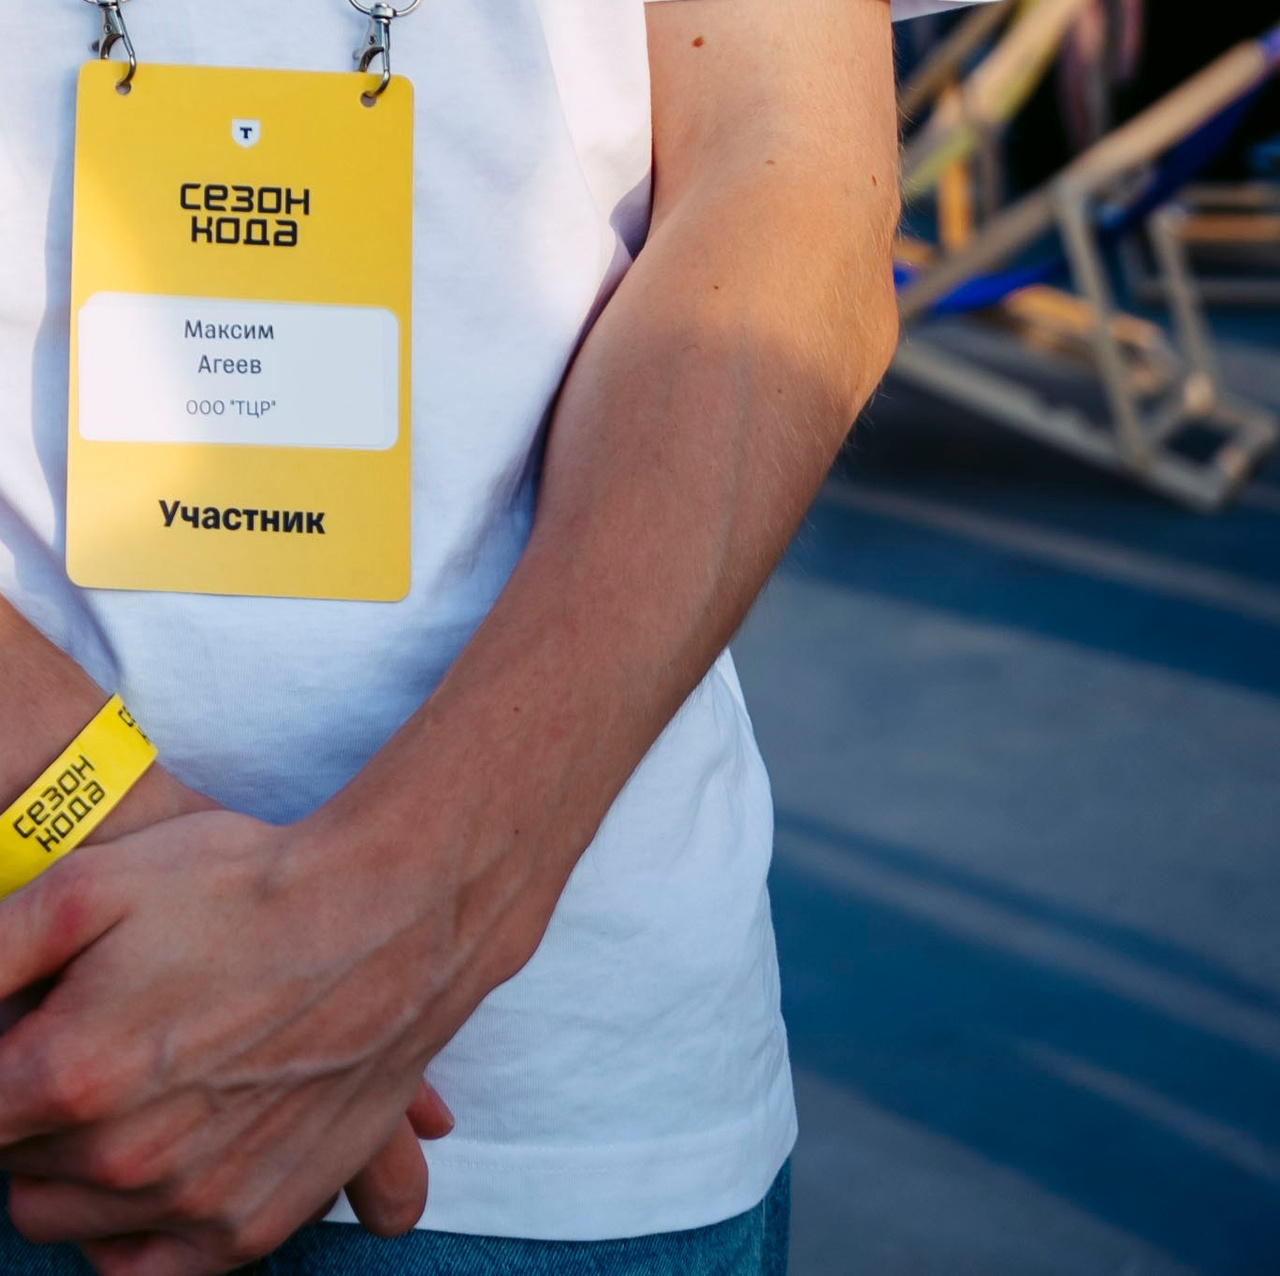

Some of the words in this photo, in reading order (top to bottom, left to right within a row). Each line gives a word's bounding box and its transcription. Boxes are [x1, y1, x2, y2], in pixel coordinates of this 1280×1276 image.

[184, 319, 275, 340] Максим
[197, 354, 262, 374] Агеев
[186, 399, 225, 415] ООО
[230, 399, 276, 418] "ТЦР"
[158, 500, 326, 534] Участник
